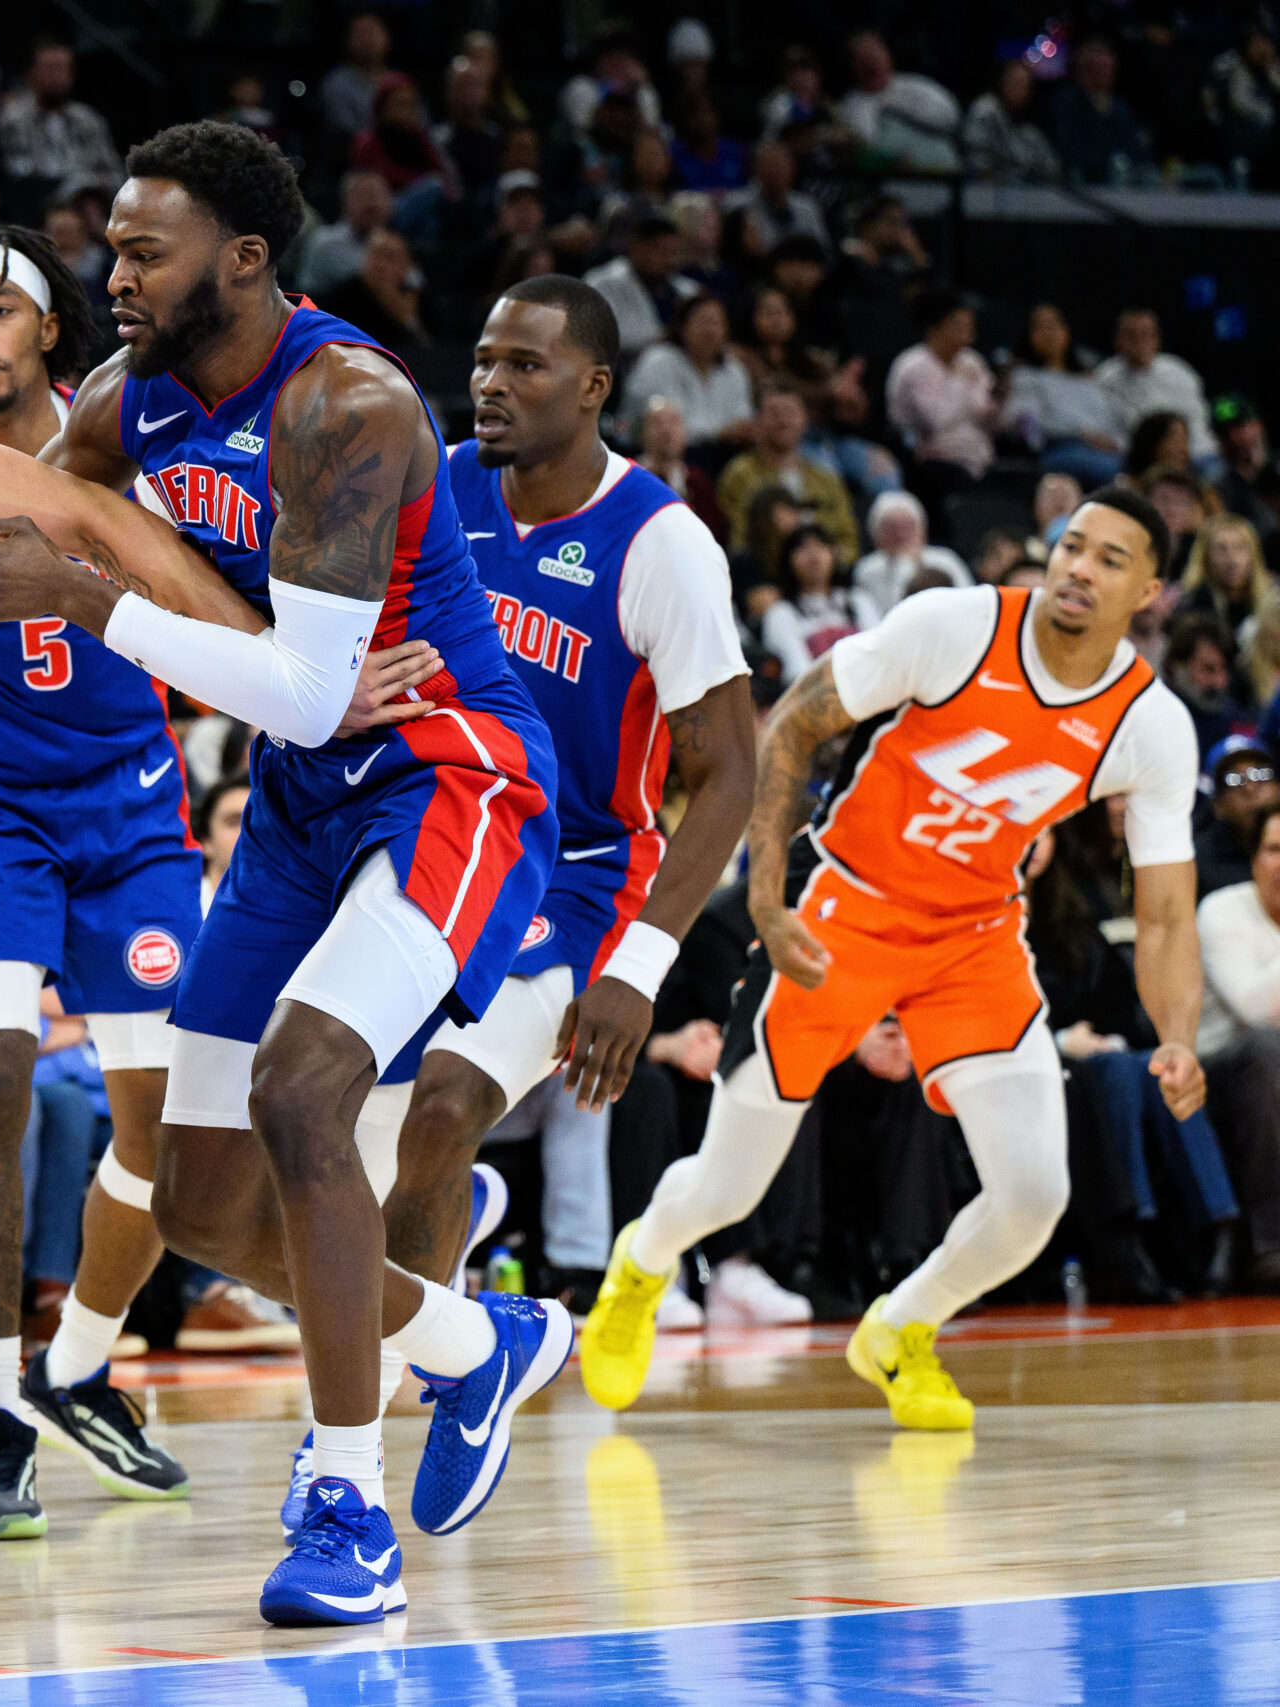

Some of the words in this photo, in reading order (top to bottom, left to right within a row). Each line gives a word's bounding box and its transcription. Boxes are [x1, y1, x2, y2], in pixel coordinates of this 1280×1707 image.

[539, 560, 592, 583] StockX
[21, 616, 73, 691] 5
[484, 589, 593, 684] ROIT
[910, 726, 1084, 826] LA
[901, 788, 1004, 864] 22
